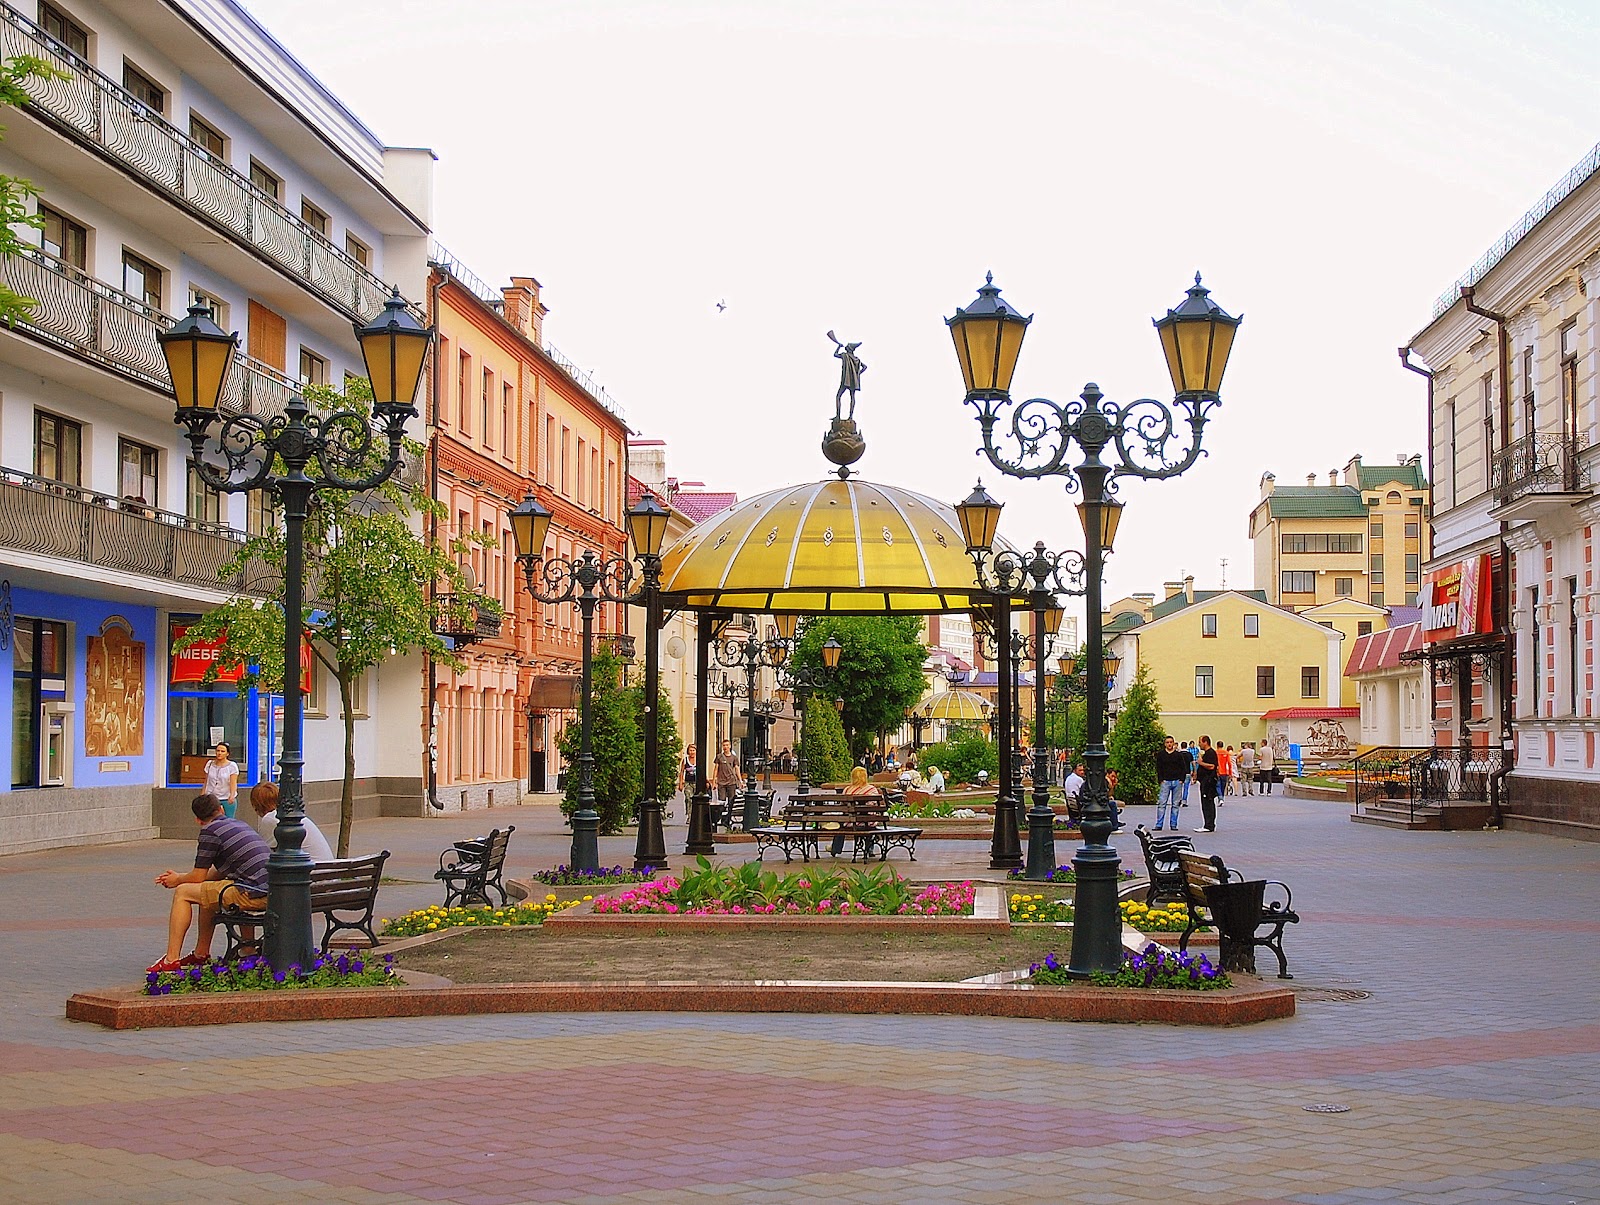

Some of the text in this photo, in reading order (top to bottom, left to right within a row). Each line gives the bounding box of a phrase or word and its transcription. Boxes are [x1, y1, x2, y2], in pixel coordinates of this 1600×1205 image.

[1416, 582, 1456, 631] 1 МАЯ
[180, 648, 222, 660] МЕБЕ
